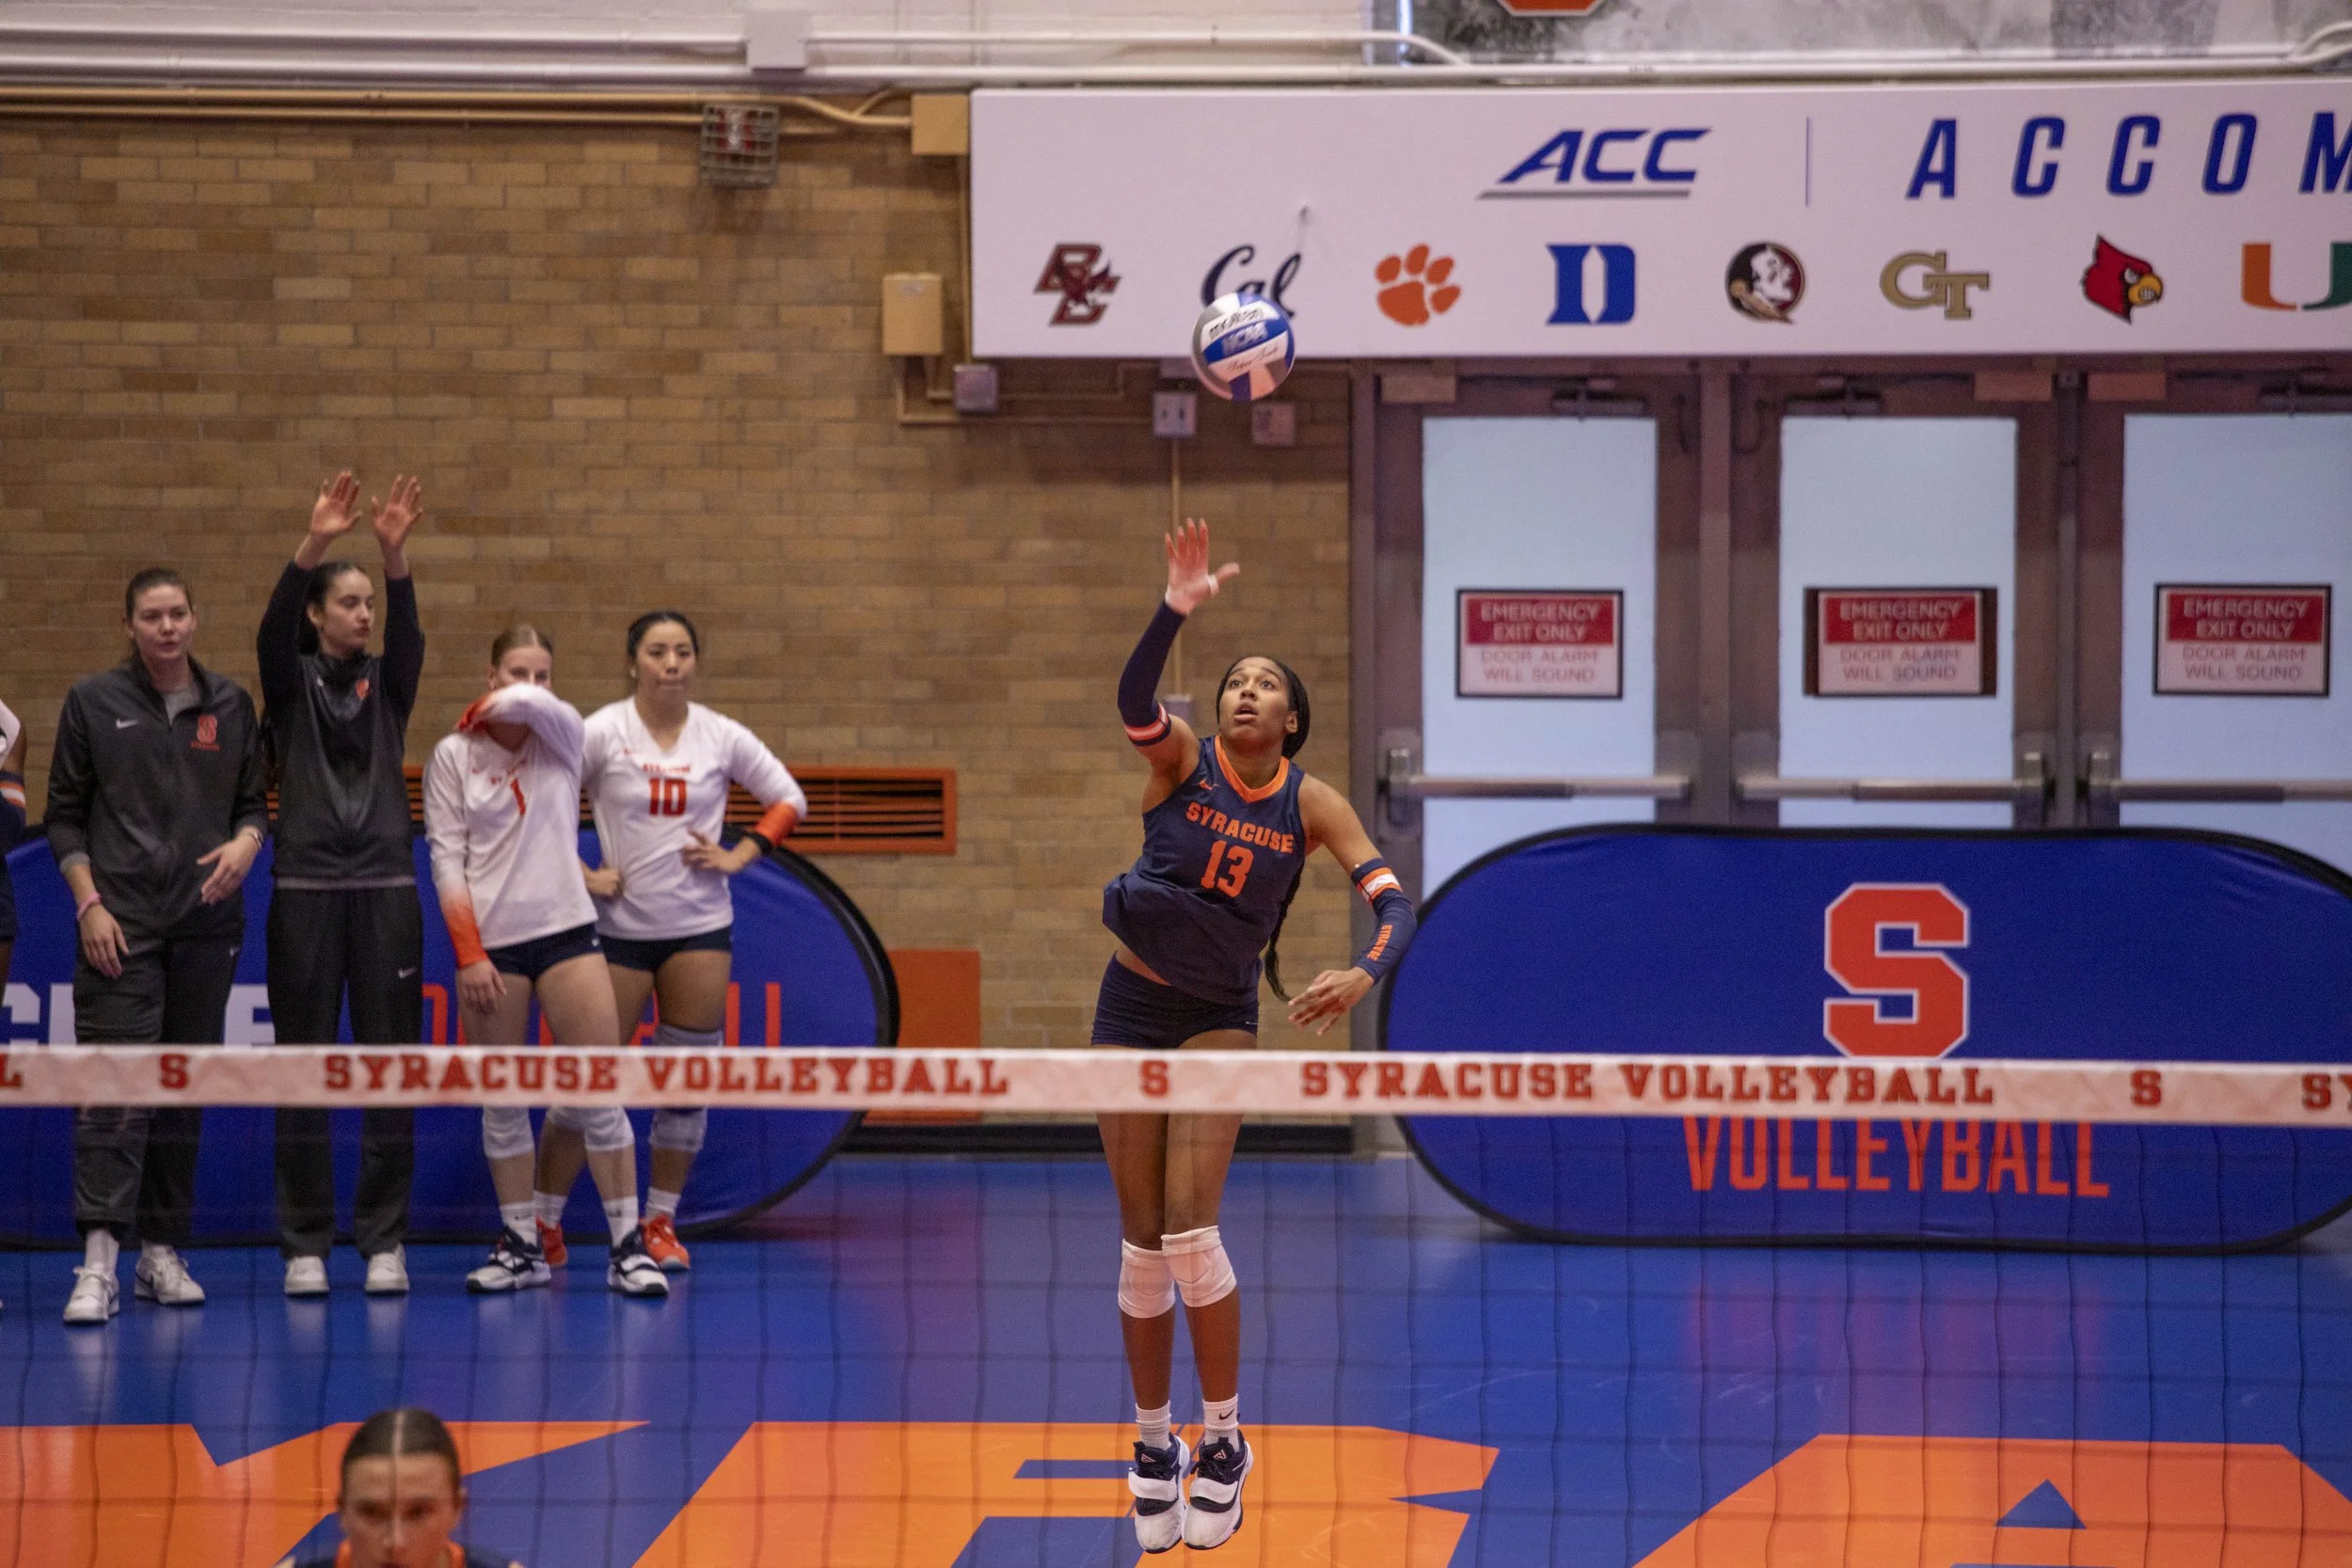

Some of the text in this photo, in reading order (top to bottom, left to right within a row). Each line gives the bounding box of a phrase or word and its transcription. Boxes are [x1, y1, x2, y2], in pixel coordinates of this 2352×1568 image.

[1498, 129, 1711, 183] ACC
[1546, 245, 1636, 325] D
[1880, 251, 1990, 320] GT
[1481, 601, 1598, 622] EMERGENCY
[1840, 600, 1963, 620] EMERGENCY
[2184, 597, 2309, 618] EMERGENCY
[1493, 623, 1587, 641] EXIT ONLY
[1853, 621, 1950, 641] EXIT ONLY
[2196, 619, 2294, 639] EXIT ONLY
[1482, 651, 1597, 663] DOOR ALARM
[1840, 647, 1960, 661] DOOR ALARM
[2183, 645, 2305, 660] DOOR ALARM
[1484, 668, 1595, 682] WILL SOUND
[1843, 665, 1957, 681] WILL SOUND
[2185, 665, 2300, 680] WILL SOUND
[648, 778, 687, 816] 10
[1185, 801, 1294, 853] SYRACUSE
[1200, 840, 1254, 897] 13
[1823, 881, 1970, 1057] S
[160, 1053, 189, 1089] S
[325, 1053, 1009, 1096] SYRACUSE VOLLEYBALL
[1140, 1059, 1171, 1097] S
[1300, 1061, 1993, 1103] SYRACUSE VOLLEYBALL
[2131, 1069, 2161, 1106] S
[1683, 1117, 2109, 1197] VOLLEYBALL
